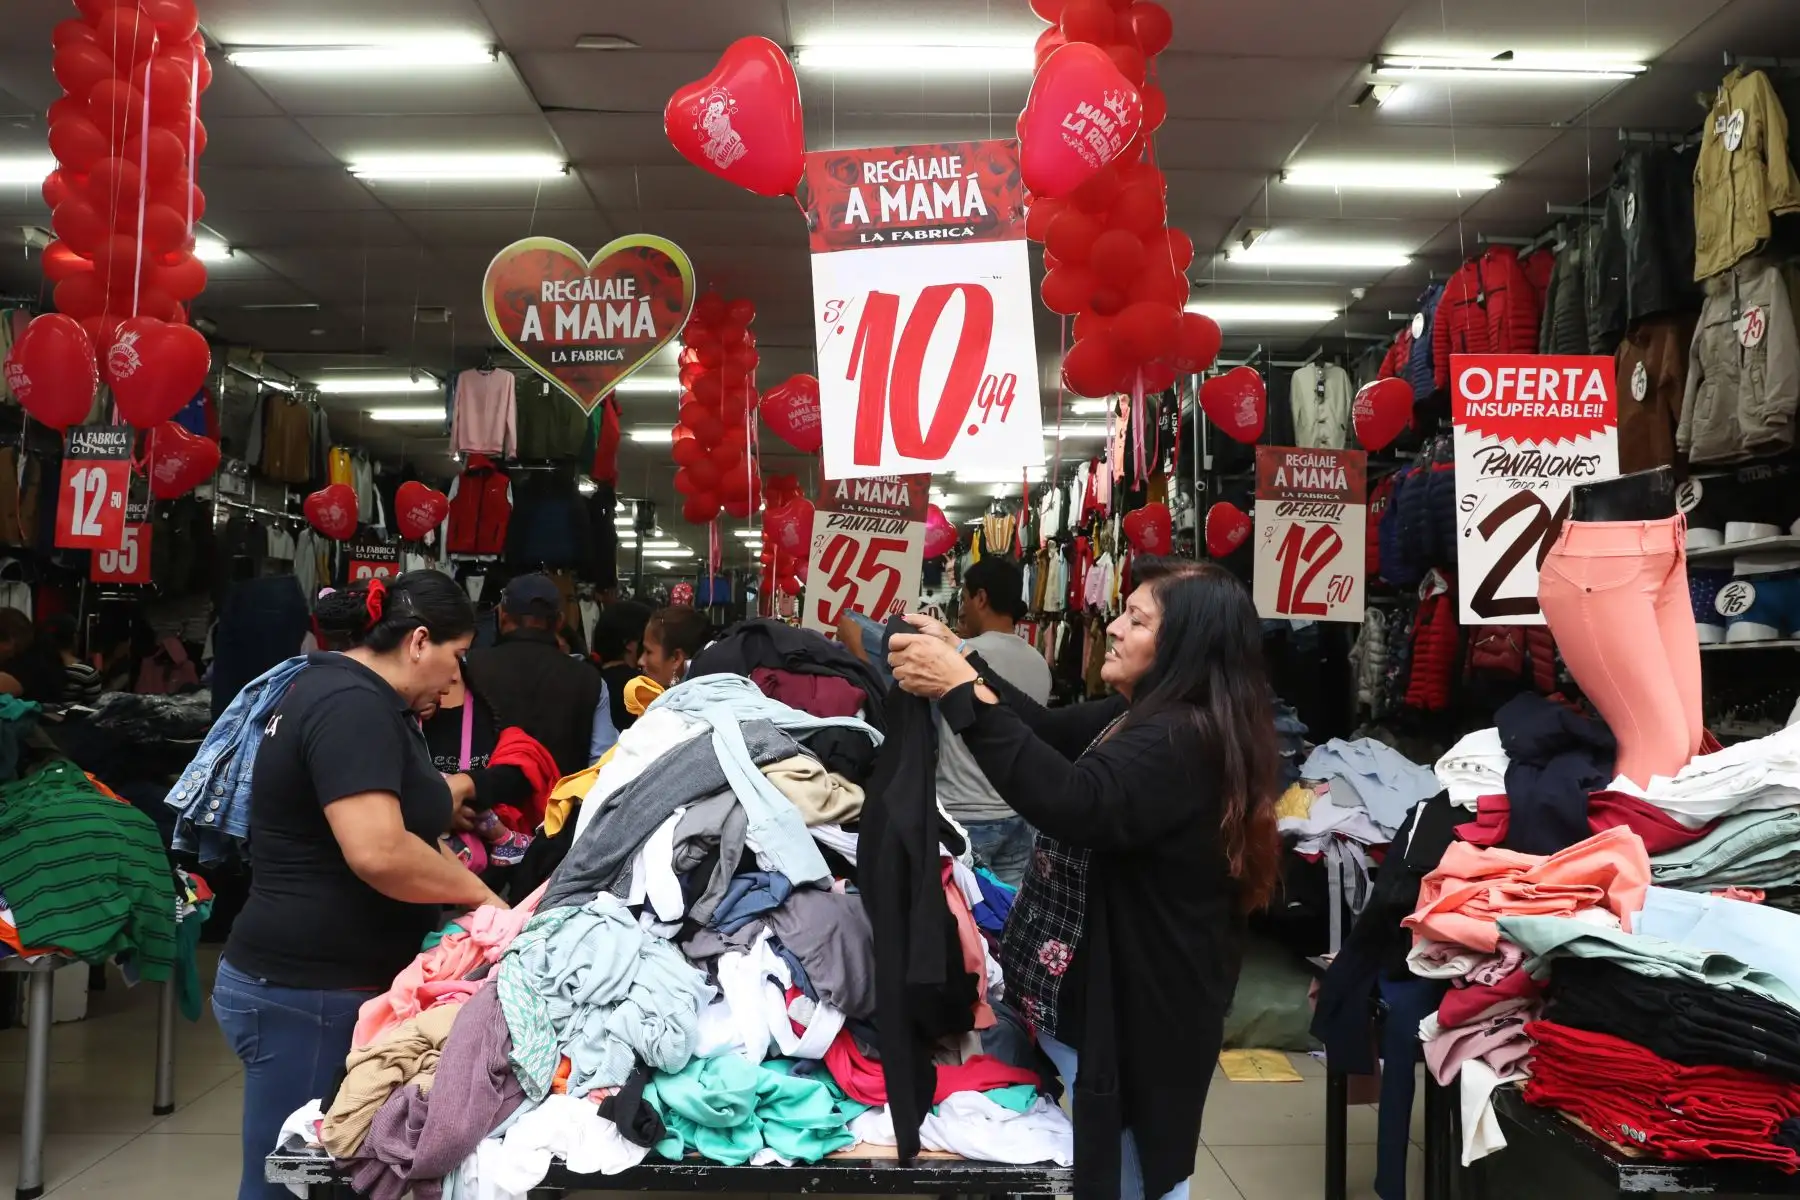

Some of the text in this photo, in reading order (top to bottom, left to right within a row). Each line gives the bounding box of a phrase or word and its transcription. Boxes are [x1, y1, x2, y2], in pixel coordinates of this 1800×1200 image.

[1062, 112, 1112, 167] LA REIN
[863, 155, 961, 184] REGÁLALE
[845, 172, 988, 224] A MAMÁ
[861, 226, 974, 243] LA FABRICA
[541, 276, 636, 302] REGÁLALE
[520, 295, 657, 341] A MAMÁ
[1743, 308, 1763, 344] 75
[551, 349, 624, 363] LA FABRICA
[1458, 367, 1608, 401] OFERTA
[802, 412, 822, 424] REIN
[1465, 402, 1604, 418] INSUPERABLE!!
[72, 432, 126, 445] LA FABRICA
[1286, 453, 1336, 469] REGÁLALE
[1472, 446, 1601, 478] PANTALONES
[1274, 466, 1348, 490] A MAMÁ
[1506, 479, 1549, 490] TODO A
[70, 467, 107, 536] 12
[111, 491, 121, 508] 50
[835, 480, 910, 507] A MAMÁ
[858, 505, 900, 516] FABRICA
[1275, 502, 1346, 521] OFERTA!
[826, 514, 909, 535] PANTALON
[355, 545, 396, 555] LA FABRICA
